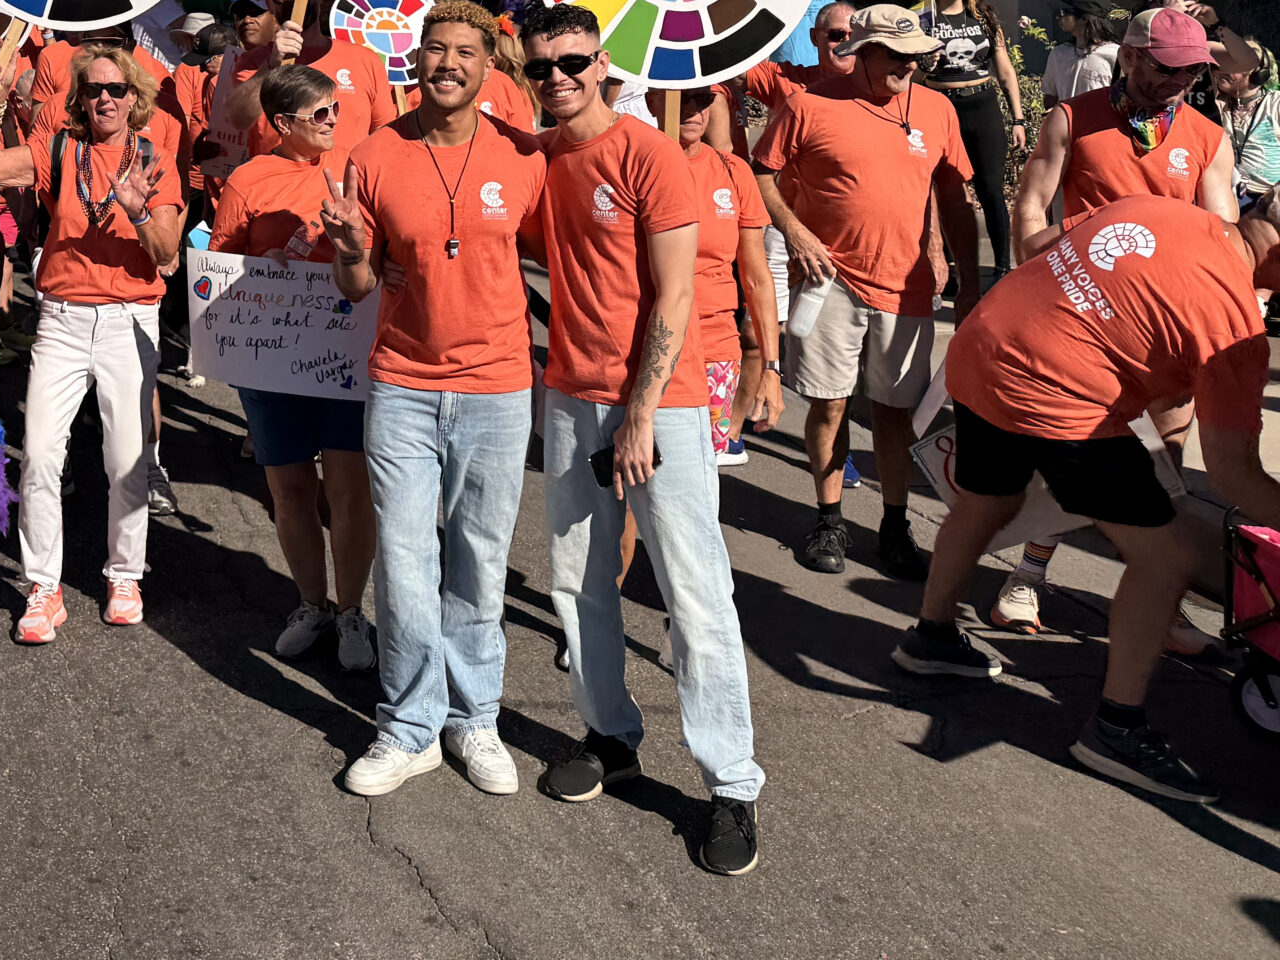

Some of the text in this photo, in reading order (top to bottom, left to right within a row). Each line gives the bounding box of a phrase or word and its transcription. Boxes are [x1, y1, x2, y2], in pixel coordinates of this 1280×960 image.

[591, 209, 619, 218] center
[197, 256, 334, 291] Always embrace your
[1046, 250, 1093, 313] ONE PRIDE
[1072, 263, 1116, 320] VOICES
[200, 307, 358, 331] for it's what sets
[215, 333, 238, 356] you
[291, 349, 346, 374] Chavela
